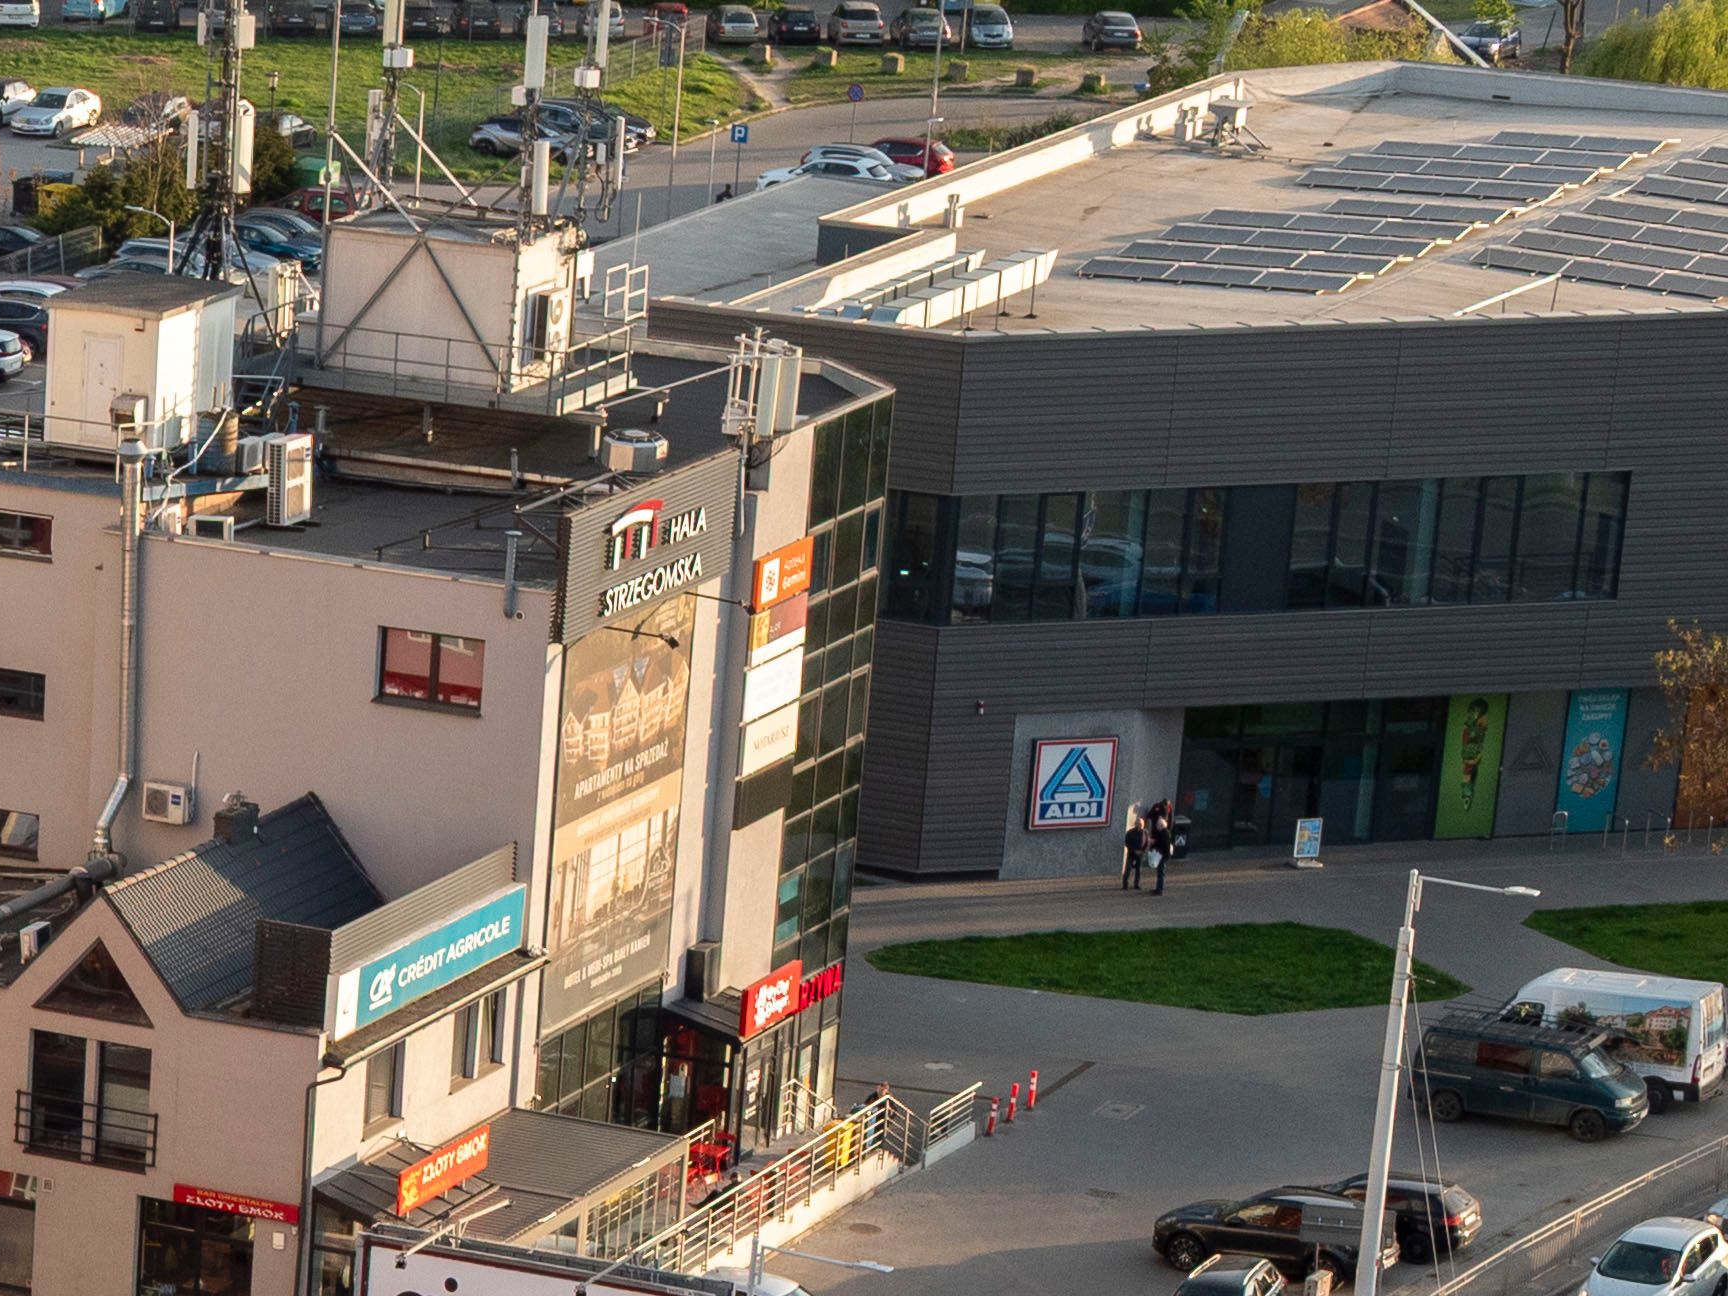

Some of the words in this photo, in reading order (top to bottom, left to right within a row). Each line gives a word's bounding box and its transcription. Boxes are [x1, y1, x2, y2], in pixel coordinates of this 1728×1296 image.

[735, 126, 745, 141] P
[669, 506, 707, 545] HALA
[604, 552, 703, 617] STRZEGOMSKA
[1044, 802, 1098, 819] ALDI
[398, 947, 446, 988] CRÉDIT
[446, 915, 511, 963] AGRICOLE
[799, 962, 842, 1012] RZYWA
[238, 1204, 284, 1220] SMOK
